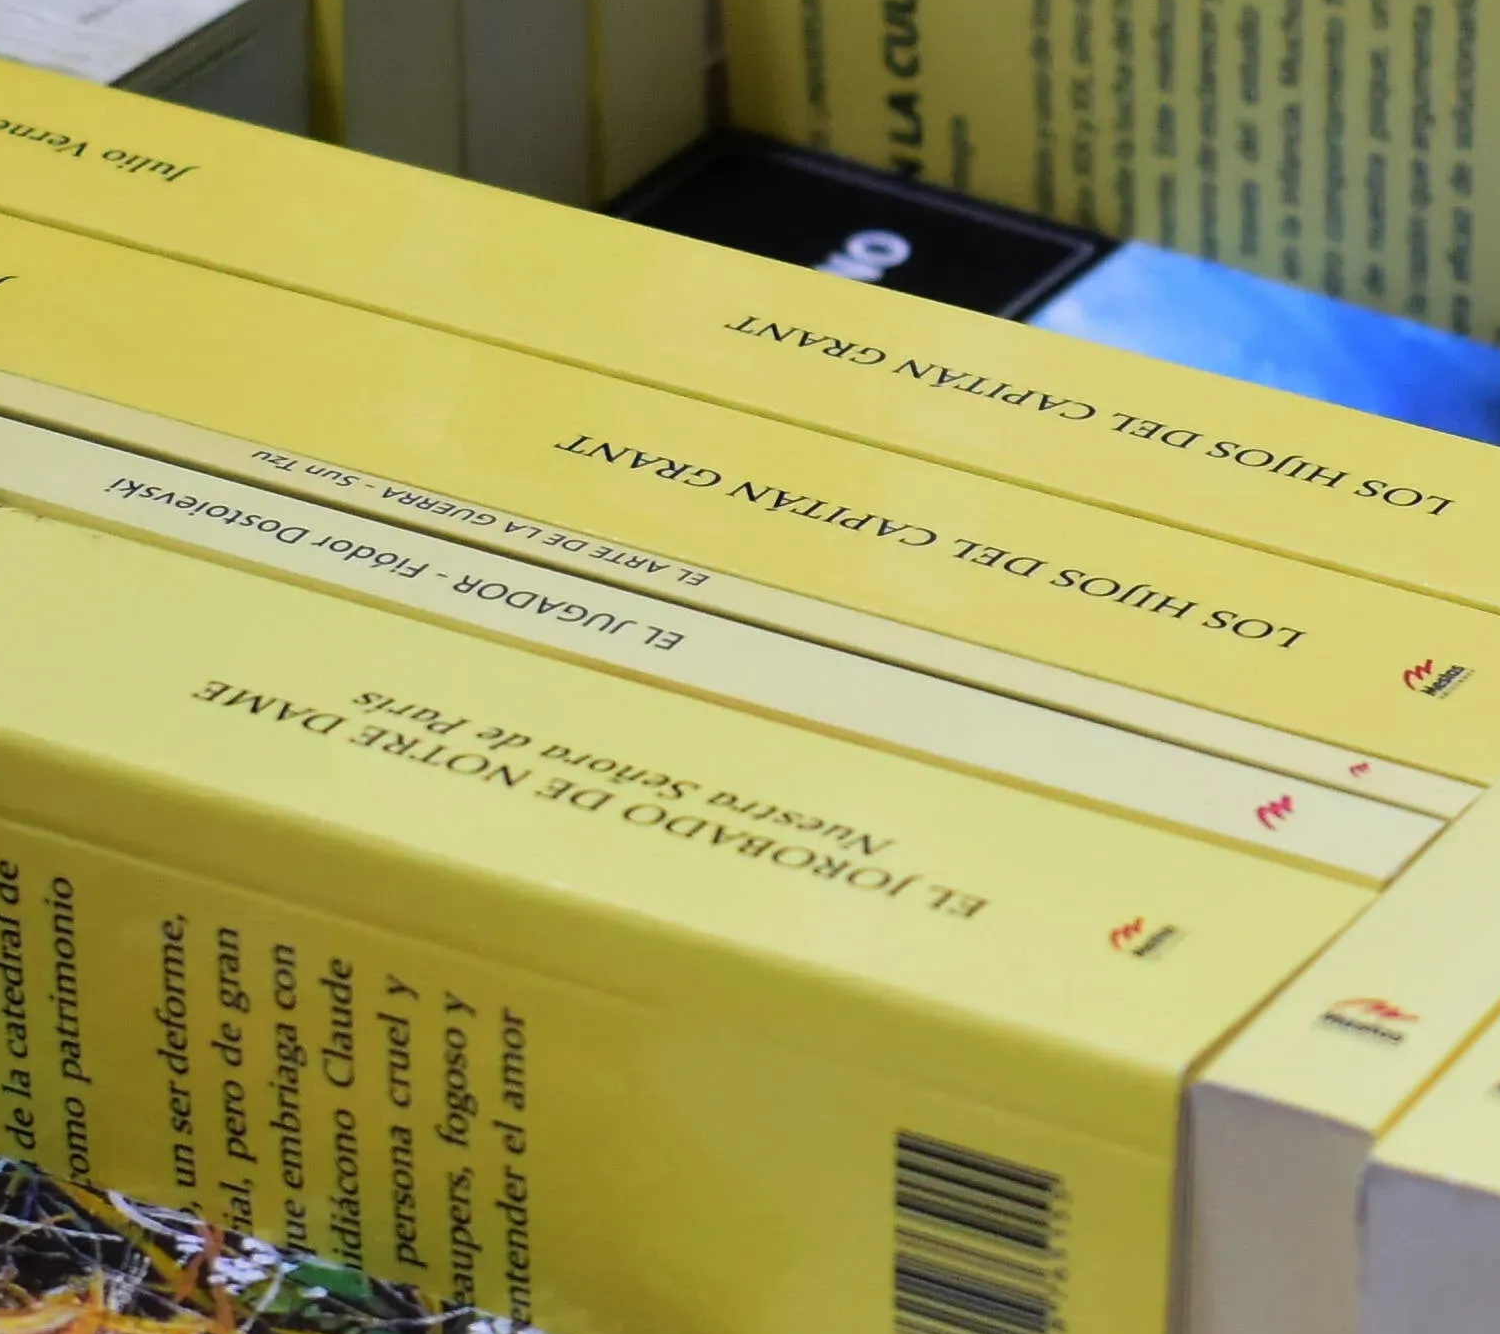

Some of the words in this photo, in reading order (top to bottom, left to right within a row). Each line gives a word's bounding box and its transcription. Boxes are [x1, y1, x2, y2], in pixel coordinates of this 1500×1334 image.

[885, 90, 923, 147] LA
[101, 149, 197, 182] Julio
[723, 315, 886, 365] GRANT
[891, 358, 1096, 420] CAPITÁN
[1112, 412, 1203, 448] DEL
[250, 450, 298, 472] Tzu
[304, 464, 360, 487] Sun
[553, 435, 722, 487] GRANT
[1205, 440, 1348, 488] HIJOS
[103, 477, 310, 544] Dostoievski
[381, 486, 497, 526] GUERRA
[726, 480, 937, 546] CAPITÁN
[1353, 479, 1453, 515] LOS
[503, 520, 543, 539] LA
[541, 532, 589, 552] DE
[310, 535, 429, 578] Fiódor
[587, 545, 670, 573] ARTE
[676, 567, 725, 586] EL
[953, 538, 1047, 577] DEL
[452, 574, 637, 634] JUGADOR
[1049, 568, 1197, 618] HIJOS
[643, 625, 684, 650] EL
[1201, 609, 1305, 648] LOS
[191, 680, 345, 734] DAME
[351, 692, 469, 735] París
[349, 725, 531, 787] NOTRE
[475, 726, 532, 750] de
[539, 744, 699, 799] Señora
[535, 780, 613, 811] DE
[706, 791, 891, 856] Nuestra
[622, 804, 916, 897] JOROBADO
[930, 888, 988, 918] EL
[0, 1068, 32, 1099] la
[3, 1106, 37, 1150] de
